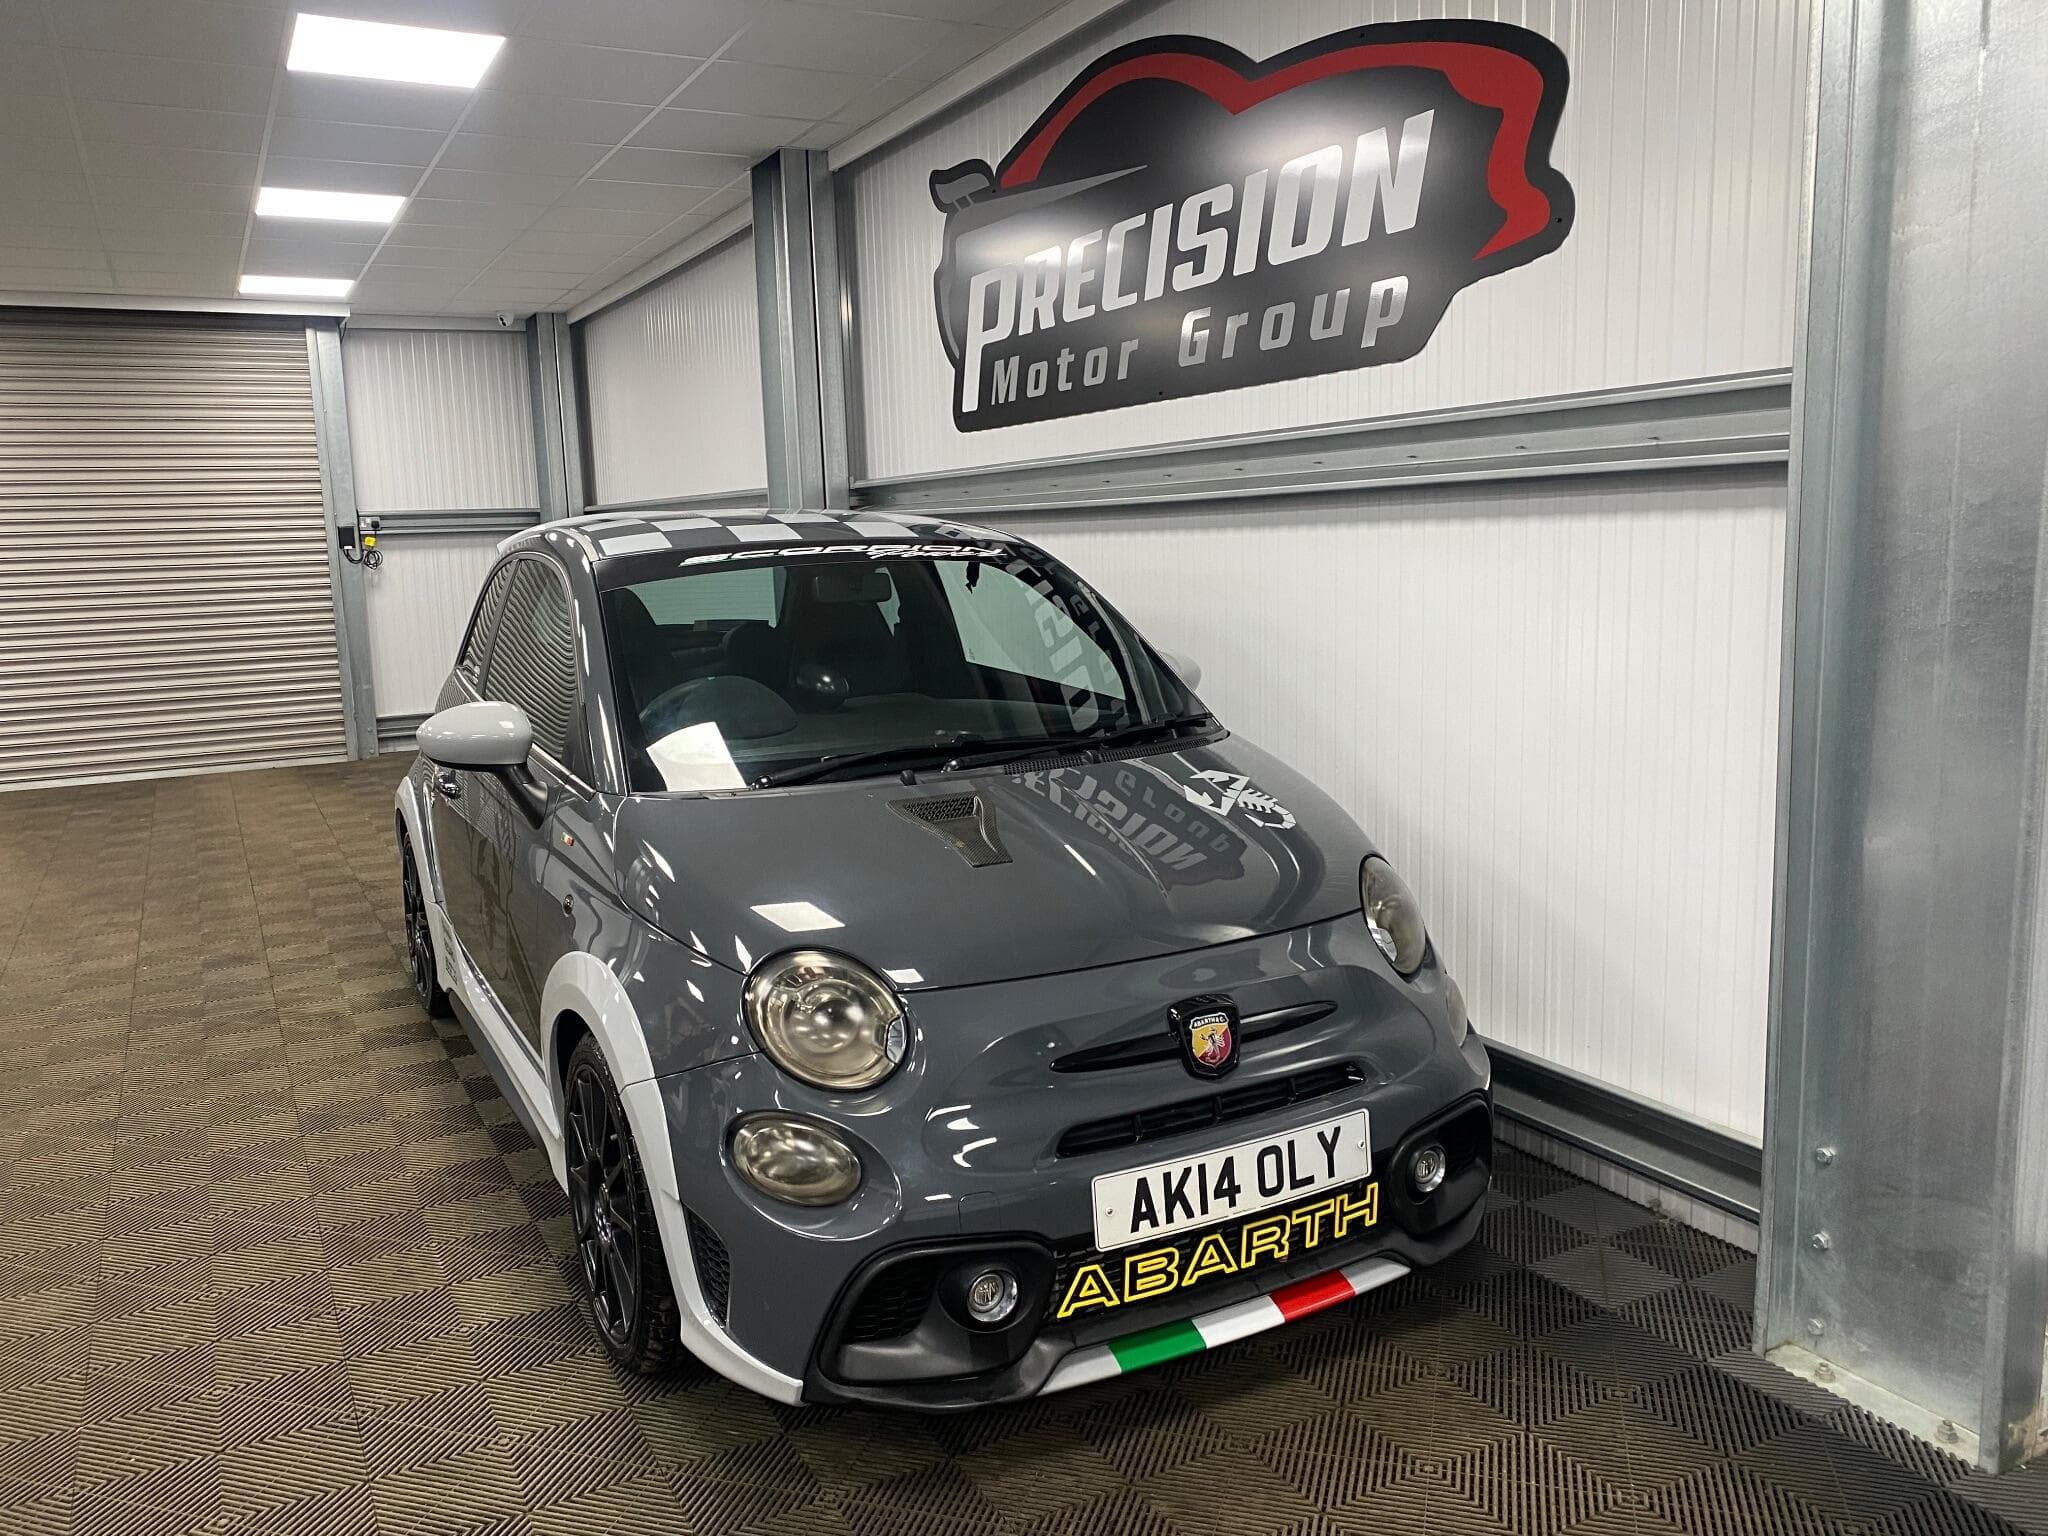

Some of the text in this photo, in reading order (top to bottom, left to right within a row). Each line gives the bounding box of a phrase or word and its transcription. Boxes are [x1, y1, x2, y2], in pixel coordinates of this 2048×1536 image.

[962, 109, 1434, 412] PRECISION
[991, 275, 1409, 405] Motor Group
[1130, 1126, 1341, 1233] AK14 OLY
[1057, 1182, 1379, 1319] ABARTH
